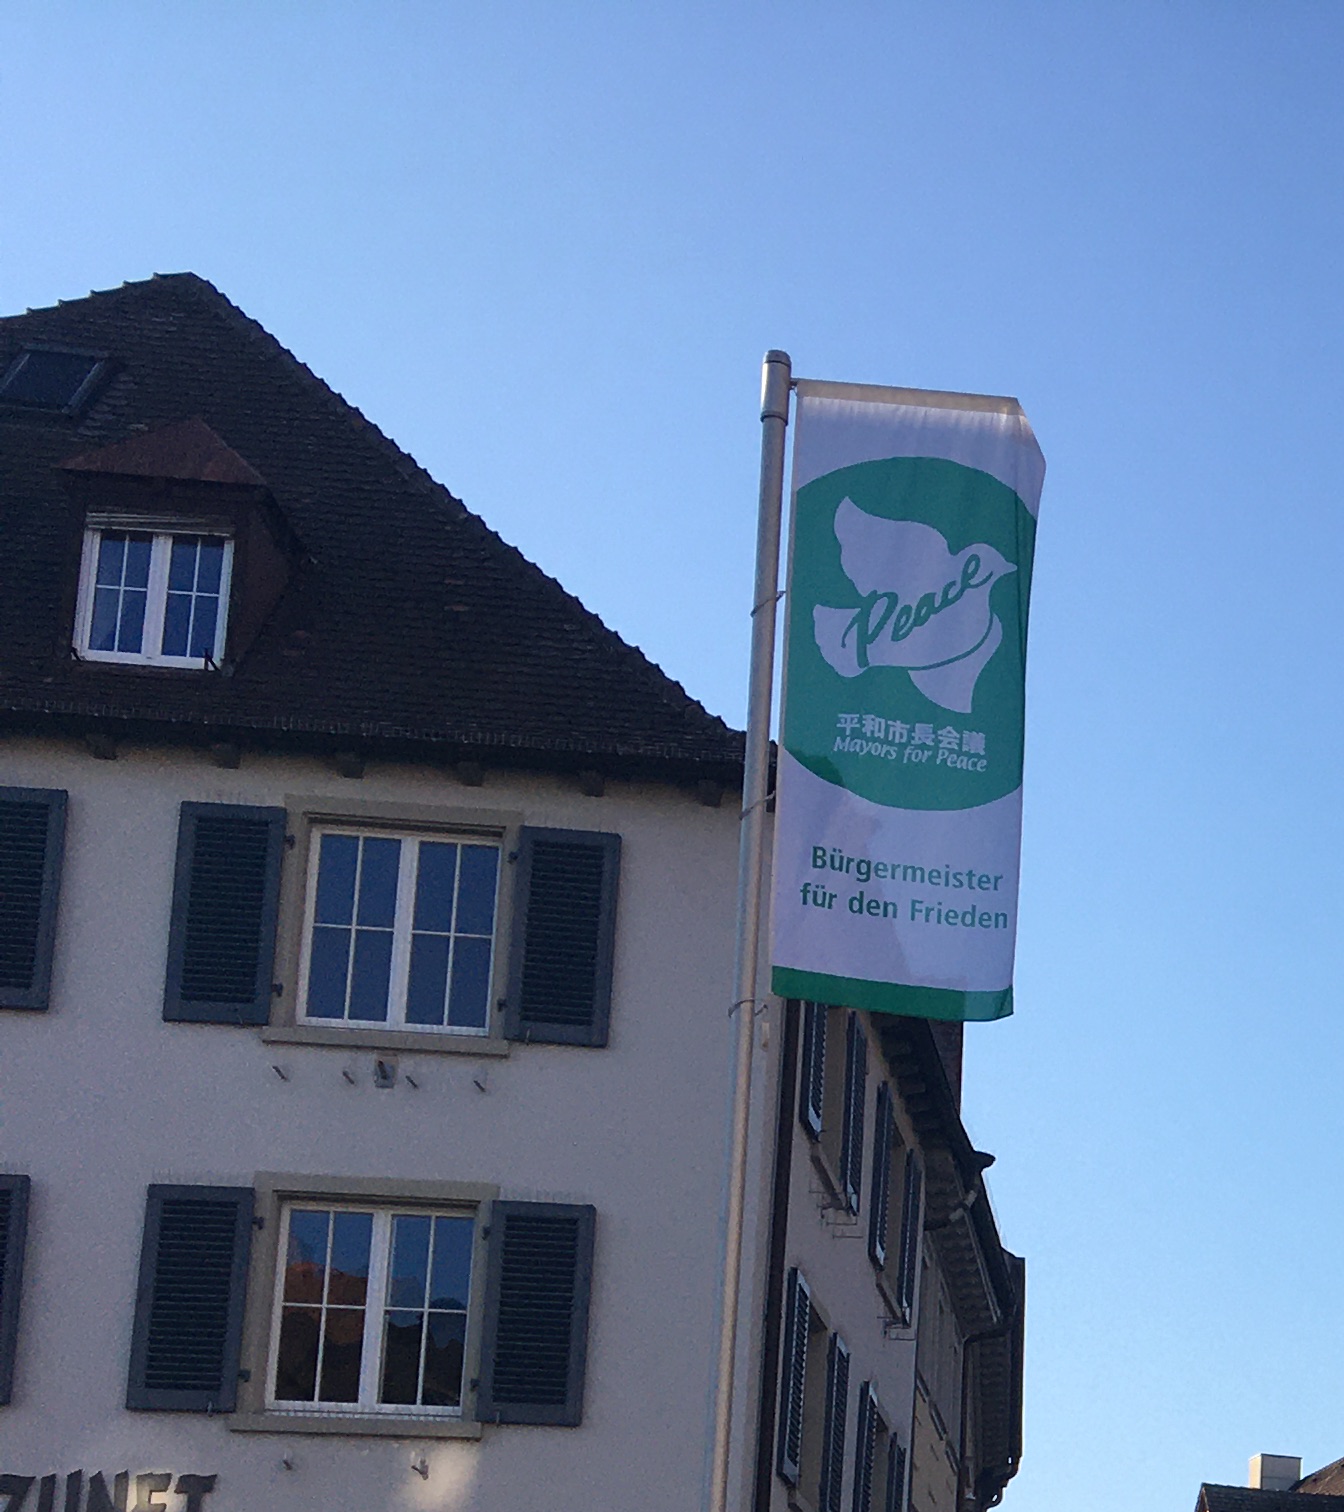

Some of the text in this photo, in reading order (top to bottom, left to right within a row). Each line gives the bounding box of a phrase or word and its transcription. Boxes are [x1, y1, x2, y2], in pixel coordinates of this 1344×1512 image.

[841, 554, 994, 669] Peace
[833, 736, 988, 773] Mayors for Peace
[836, 713, 986, 756] 平和市長会議
[811, 846, 1004, 892] Bürgermeister
[800, 882, 1009, 930] für den Frieden
